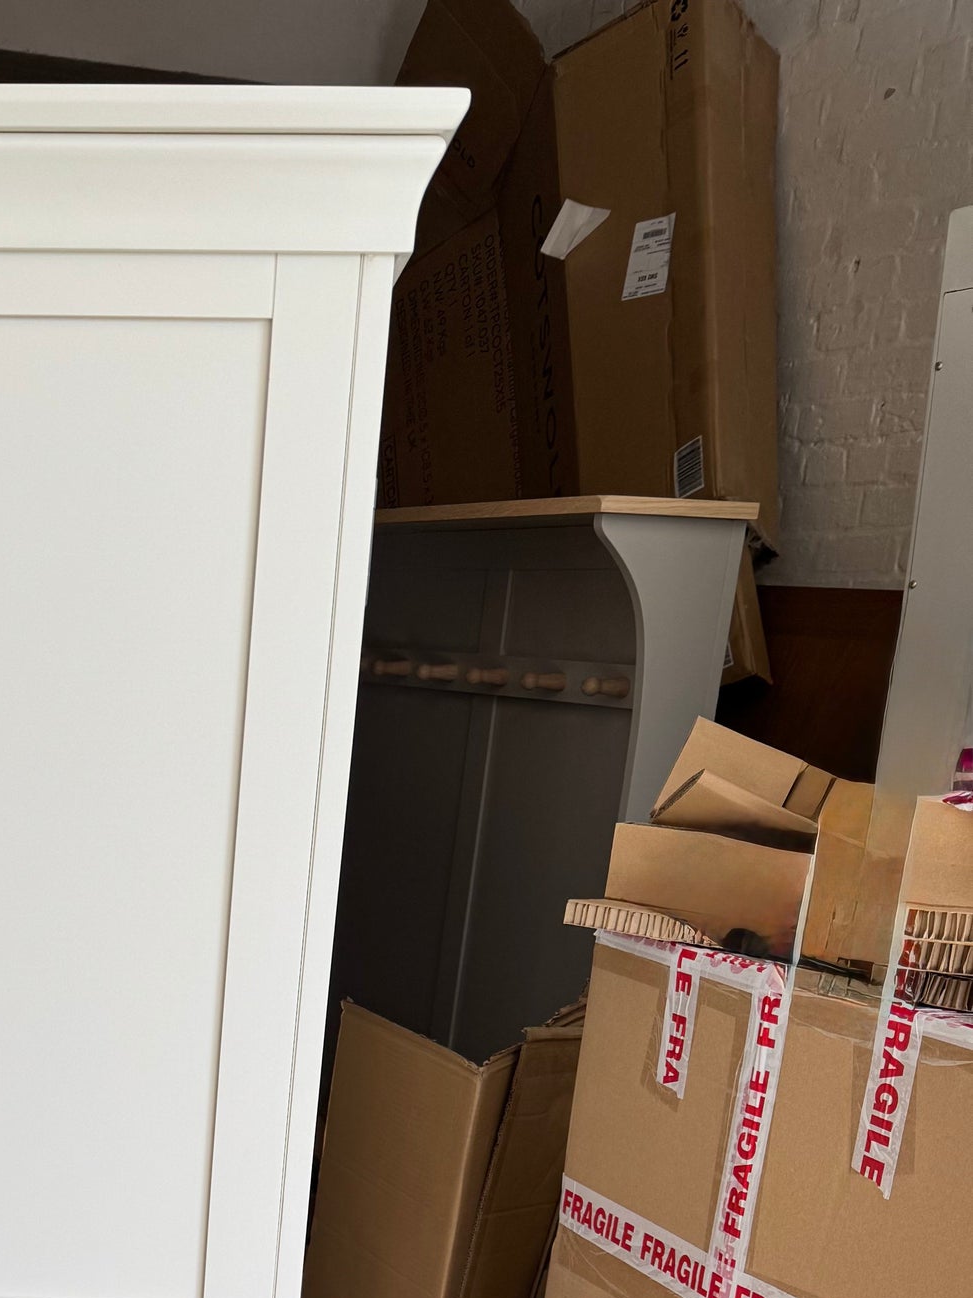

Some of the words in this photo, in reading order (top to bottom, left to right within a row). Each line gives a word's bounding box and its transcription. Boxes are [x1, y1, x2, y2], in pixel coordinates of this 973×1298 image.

[532, 195, 562, 498] COTSWOL
[562, 1189, 635, 1253] FRAGILE
[722, 1067, 770, 1239] FRAGILE
